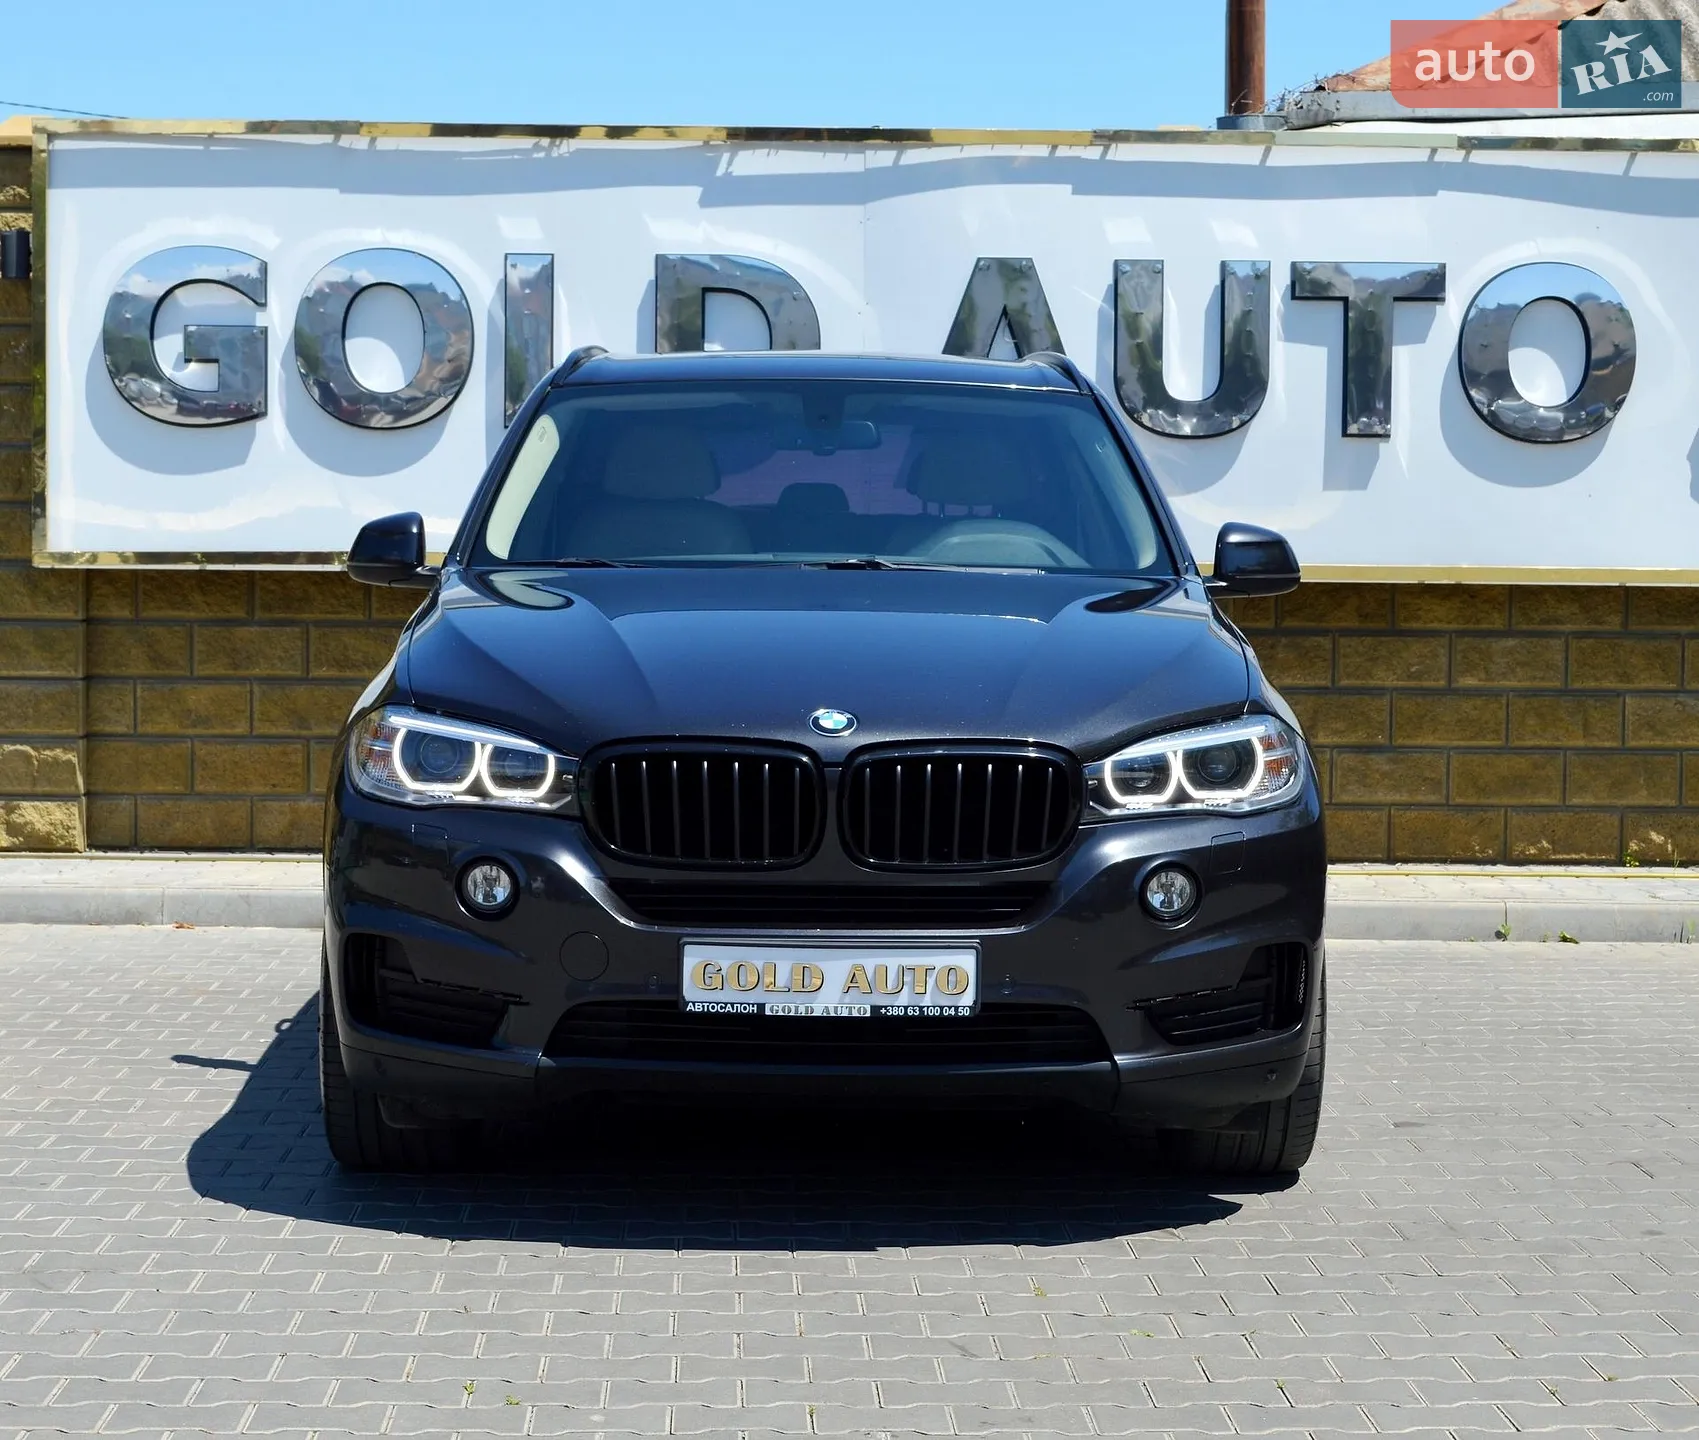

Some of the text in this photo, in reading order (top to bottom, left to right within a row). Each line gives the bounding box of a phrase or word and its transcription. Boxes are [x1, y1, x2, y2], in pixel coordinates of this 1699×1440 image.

[943, 257, 1637, 444] AUTO
[690, 960, 970, 995] GOLD AUTO
[686, 1002, 758, 1014] АВТОСАЛОН
[769, 1004, 868, 1016] GOLD AUTO
[880, 1006, 970, 1016] +380 63 100 04 50
